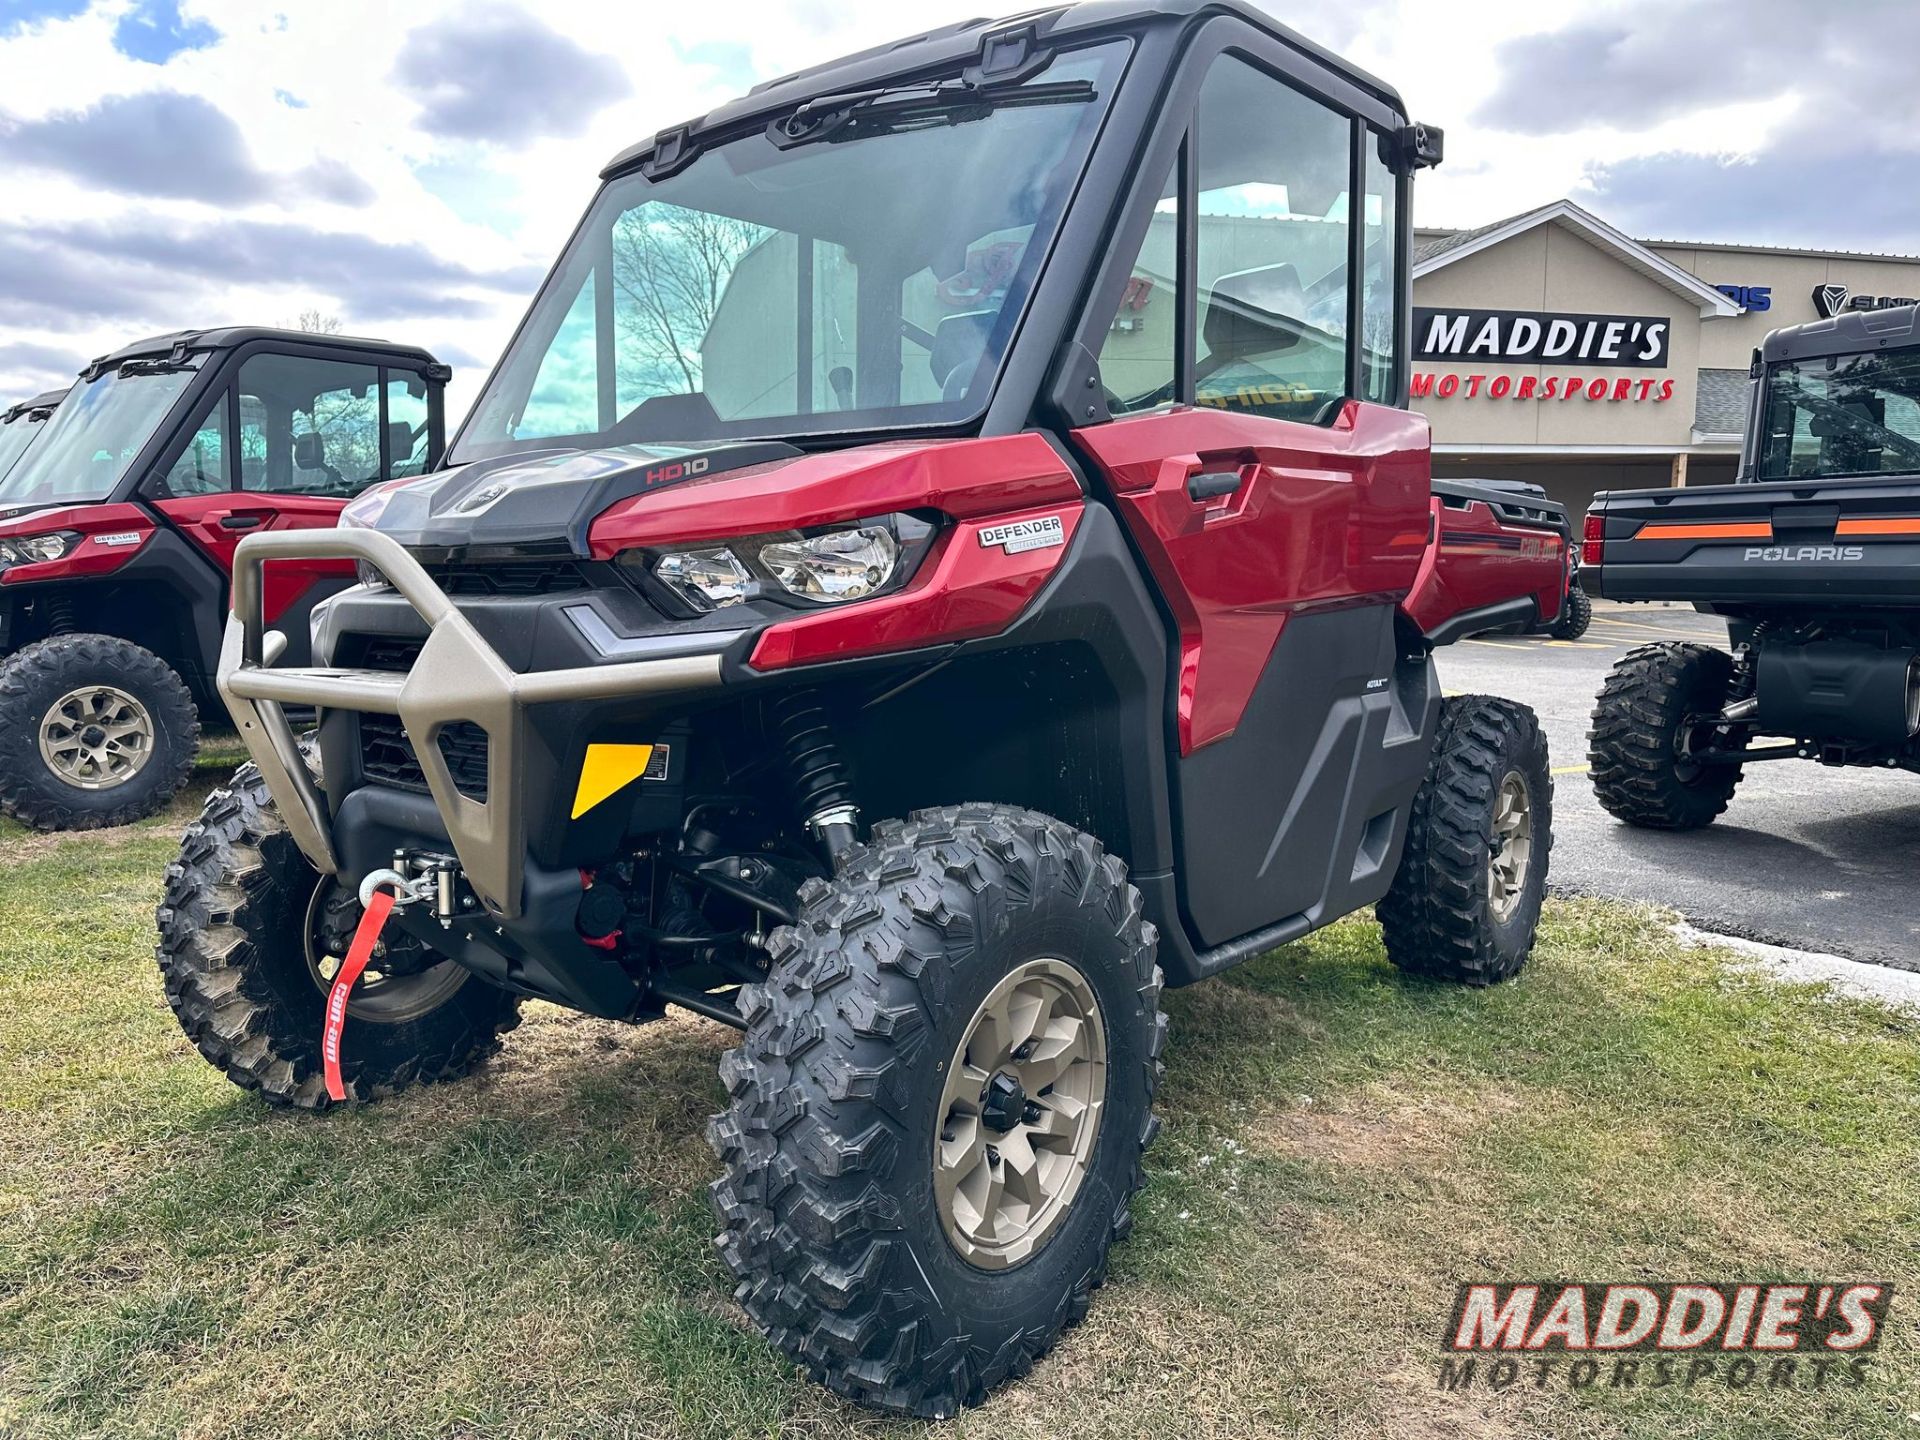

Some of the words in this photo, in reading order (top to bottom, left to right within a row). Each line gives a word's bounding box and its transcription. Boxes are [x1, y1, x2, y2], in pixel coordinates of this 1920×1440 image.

[1424, 314, 1666, 361] MADDIE'S
[1409, 373, 1675, 401] MOTORSPORTS
[646, 457, 709, 485] HD10
[983, 518, 1060, 542] DEFENDER
[1744, 547, 1863, 561] POLARIS
[327, 982, 348, 1064] can-am
